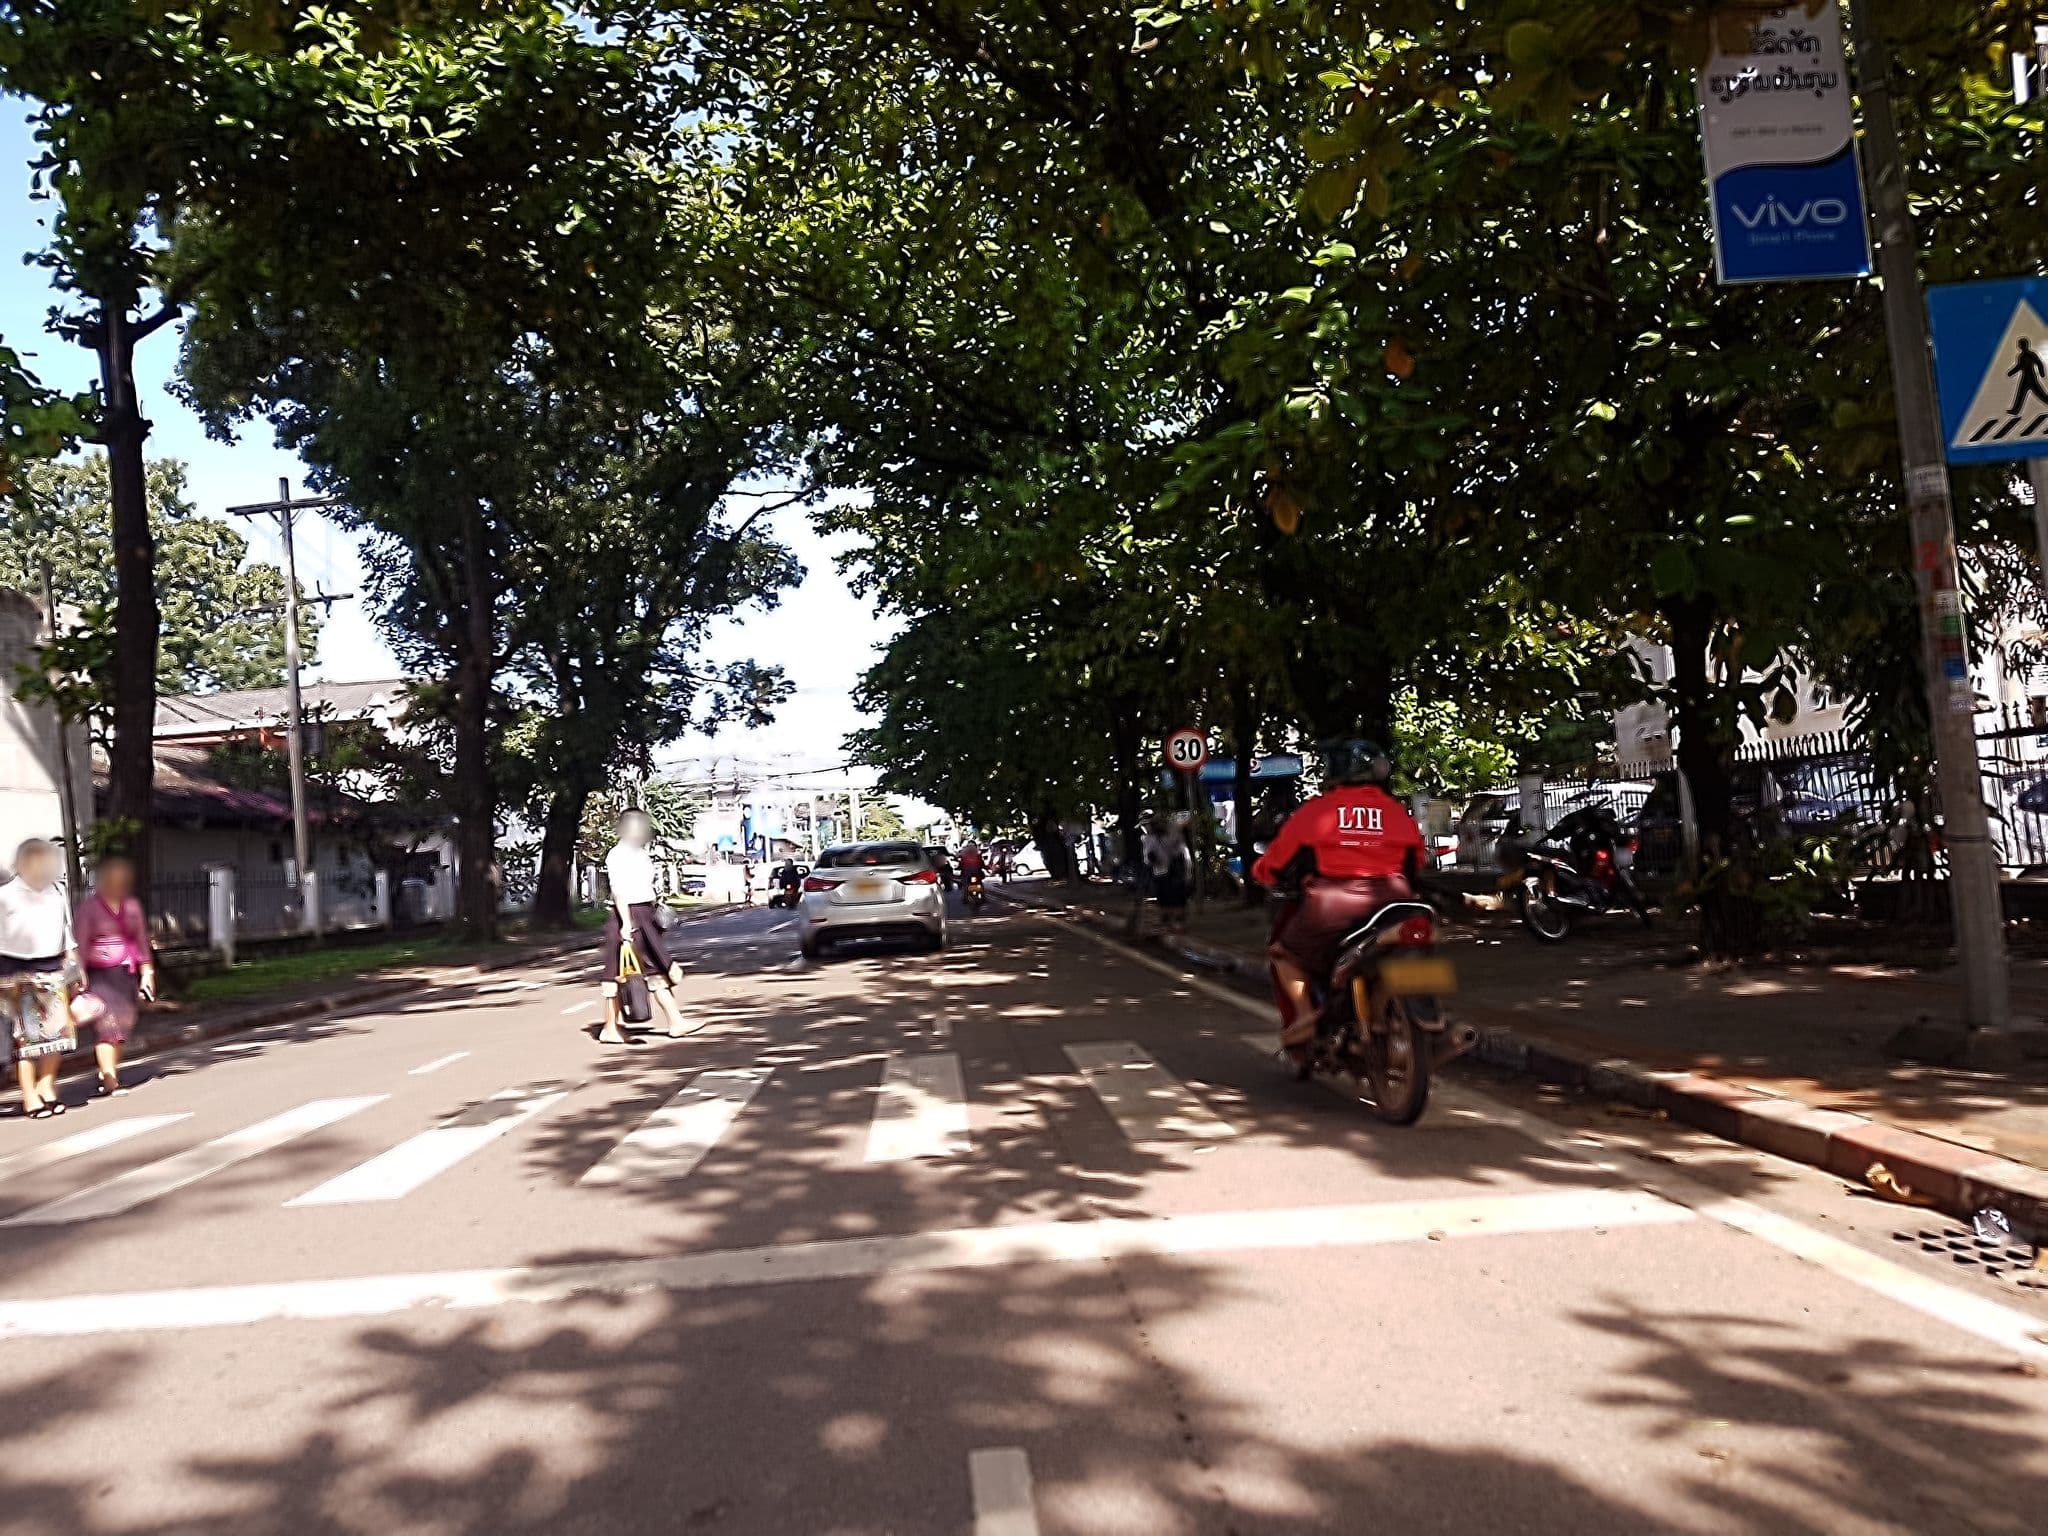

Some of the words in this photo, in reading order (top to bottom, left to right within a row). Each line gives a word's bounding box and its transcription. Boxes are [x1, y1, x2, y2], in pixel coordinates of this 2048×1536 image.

[1731, 194, 1847, 228] vivo
[1173, 738, 1201, 761] 30
[1337, 806, 1383, 830] LTH
